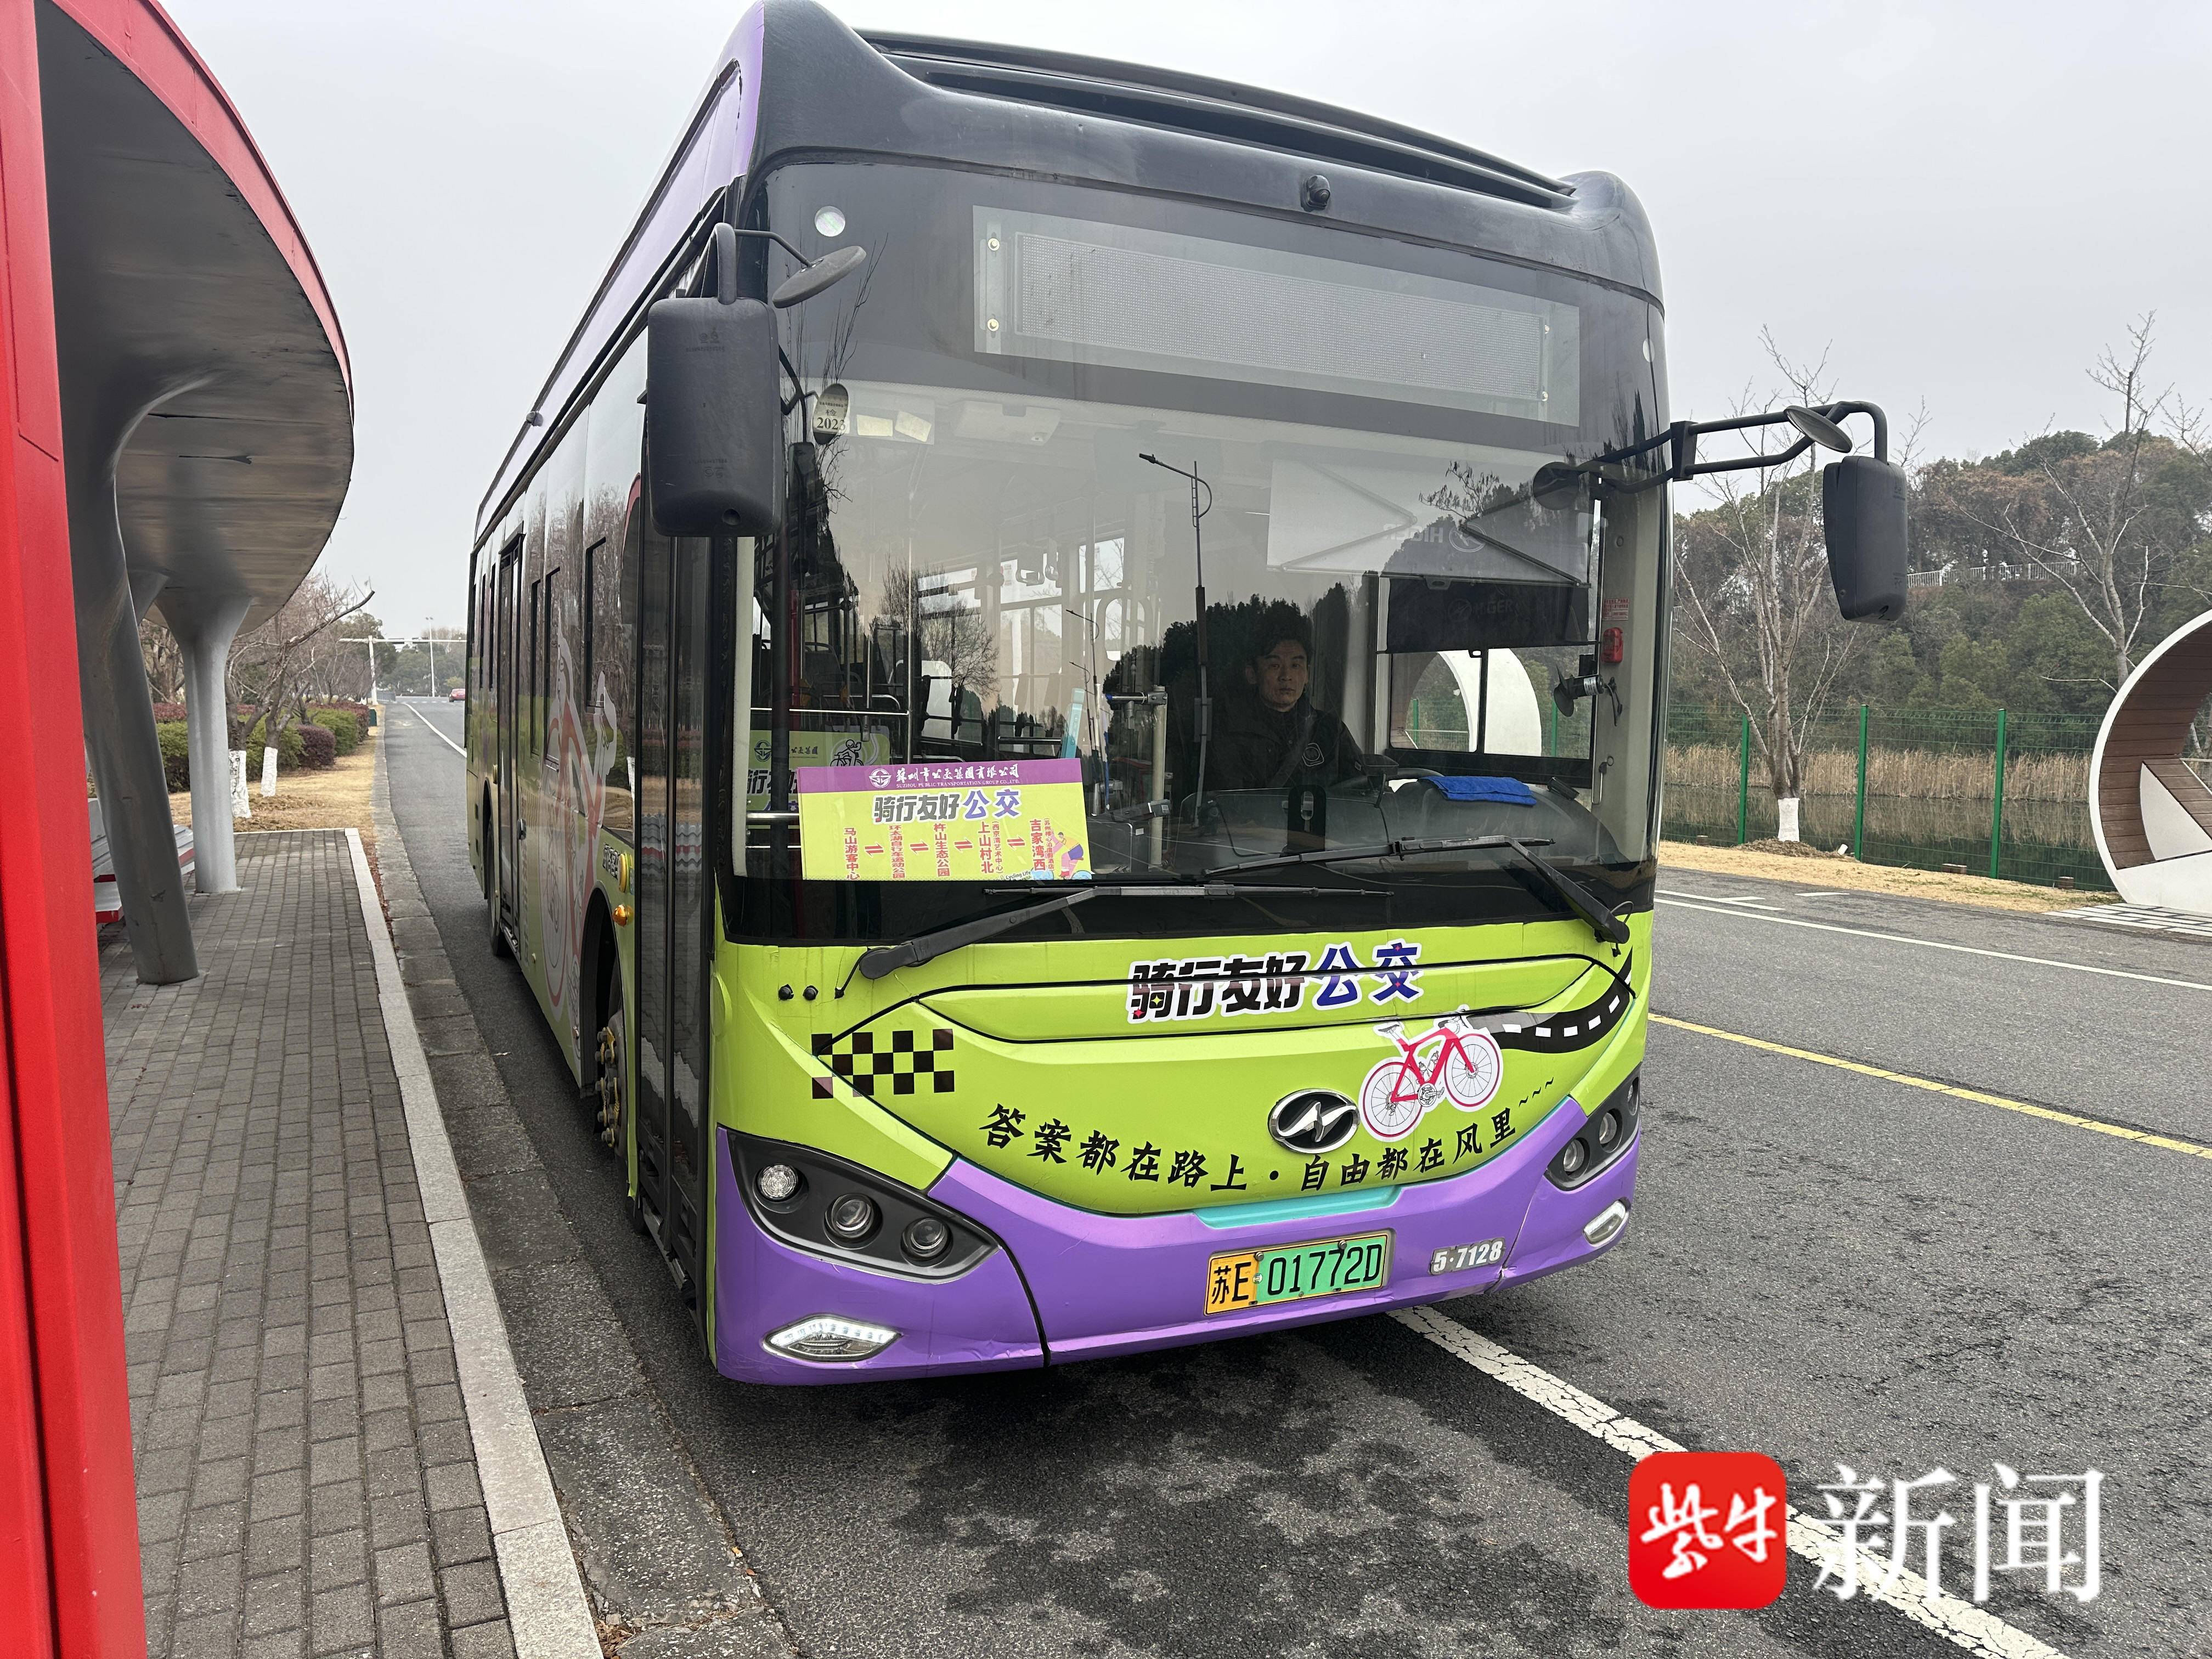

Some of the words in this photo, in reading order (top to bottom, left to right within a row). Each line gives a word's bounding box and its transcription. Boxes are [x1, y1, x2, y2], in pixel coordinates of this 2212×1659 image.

[874, 789, 1019, 822] 骑行友好公交
[844, 827, 860, 880] 马山游客中心
[978, 821, 994, 873] 上山村北
[1029, 819, 1046, 871] 吉家湾西
[1131, 942, 1423, 1020] 骑行友好公交
